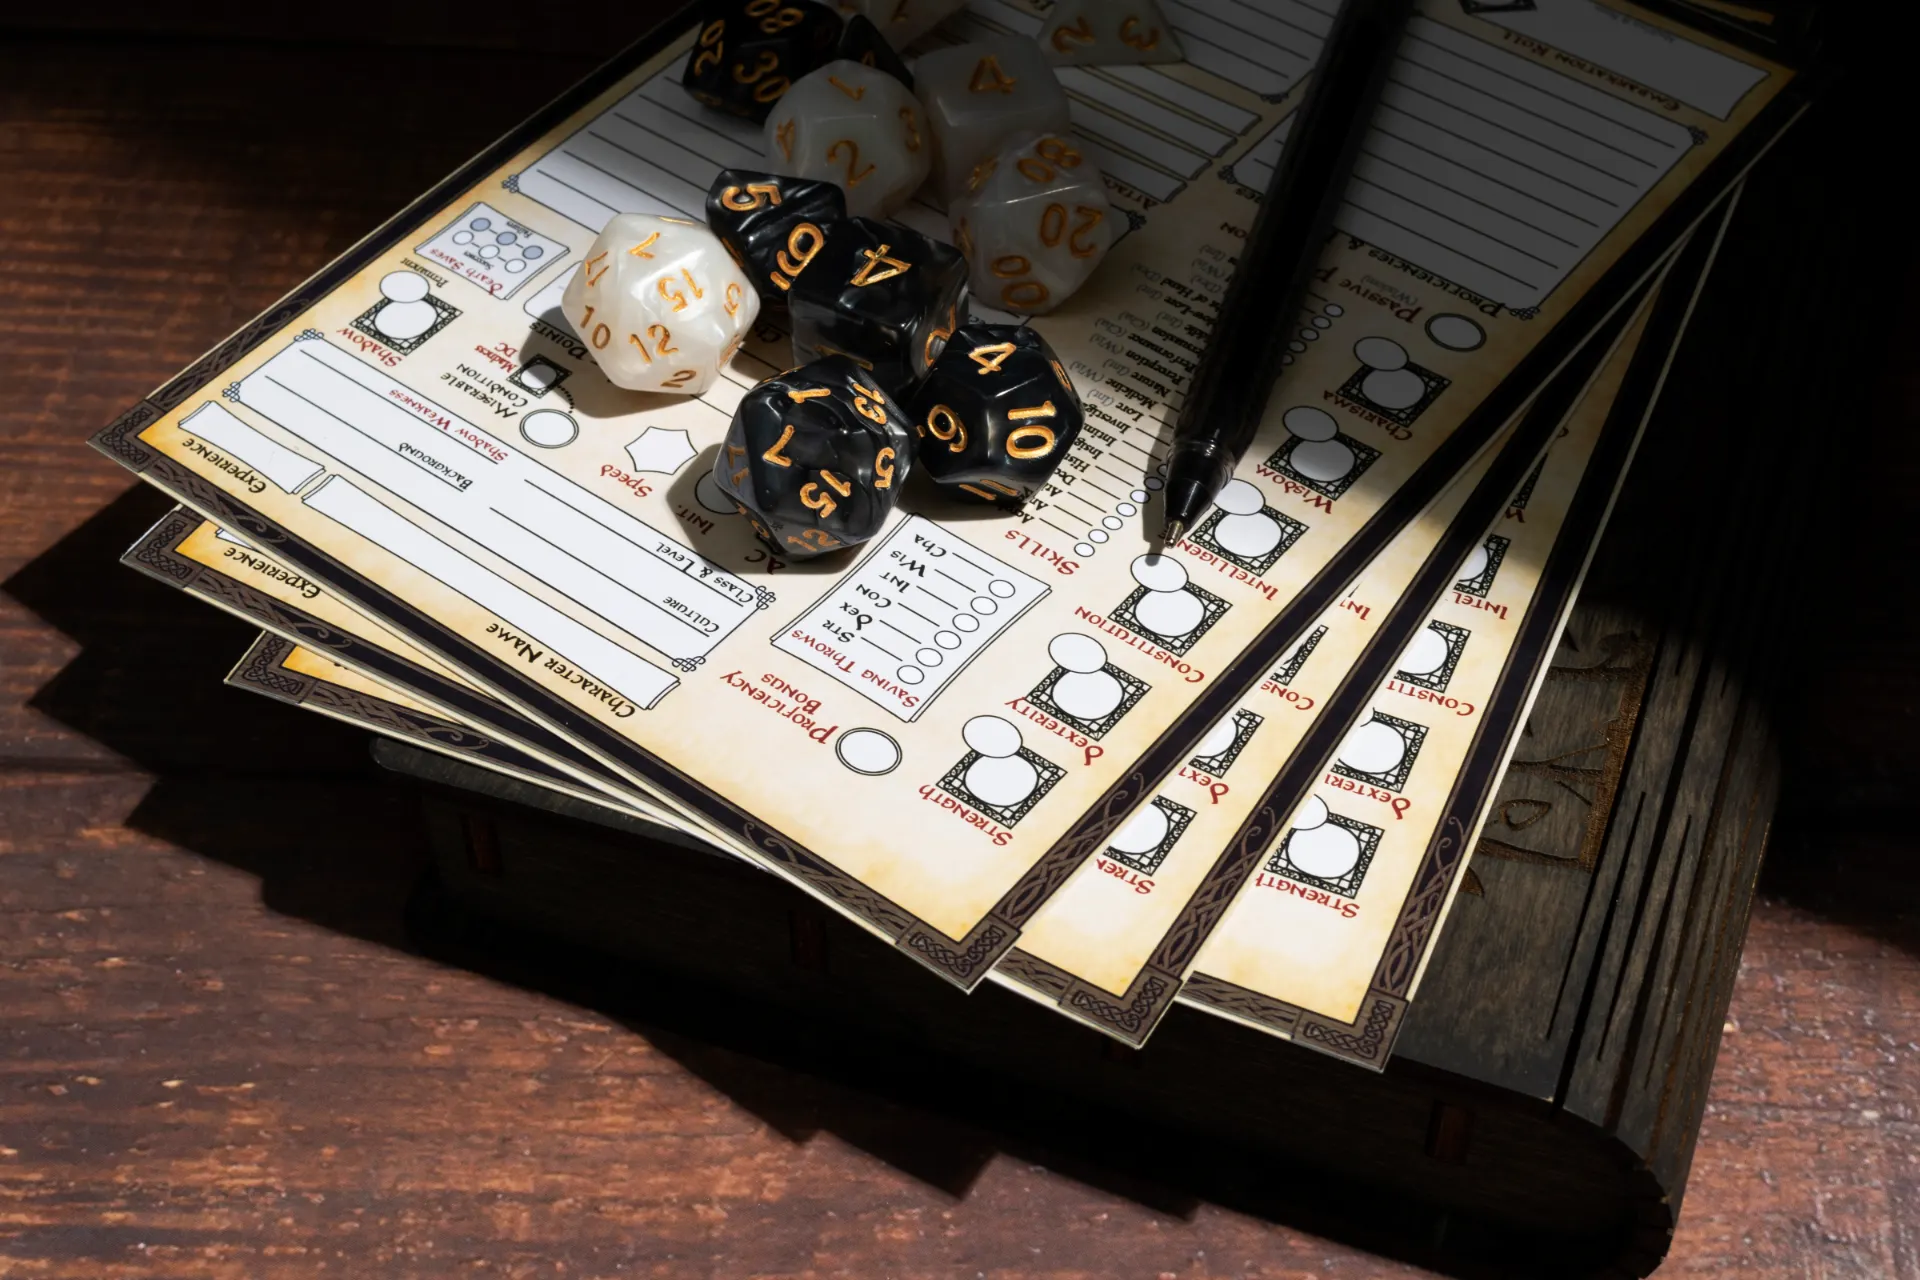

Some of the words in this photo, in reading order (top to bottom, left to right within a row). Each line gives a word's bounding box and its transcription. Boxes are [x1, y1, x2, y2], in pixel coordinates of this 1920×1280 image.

[1053, 16, 1095, 54] 2
[1119, 16, 1160, 50] 3
[732, 50, 791, 103] 30
[968, 55, 1016, 93] 4
[827, 140, 876, 187] 2
[1016, 137, 1082, 183] 80
[721, 183, 784, 213] 5
[628, 231, 661, 260] 7
[1040, 203, 1103, 258] 20
[401, 258, 448, 288] Permanent
[849, 243, 913, 288] 4
[657, 267, 704, 313] 15
[580, 304, 611, 350] 10
[628, 323, 681, 364] 12
[1152, 327, 1206, 359] ersuasion
[475, 346, 516, 372] Madness
[495, 343, 517, 357] DC
[968, 342, 1018, 376] 4
[660, 369, 698, 389] 2
[1126, 351, 1185, 385] Perception
[1131, 372, 1170, 397] Nature
[788, 388, 832, 404] 1
[1106, 379, 1158, 409] Medicine
[1116, 403, 1144, 421] Lore
[762, 424, 796, 468] 7
[1006, 400, 1058, 460] 10
[874, 447, 897, 490] 5
[800, 469, 852, 519] 15
[700, 567, 713, 577] &
[745, 549, 786, 573] AC
[1156, 528, 1278, 600] Intelligene
